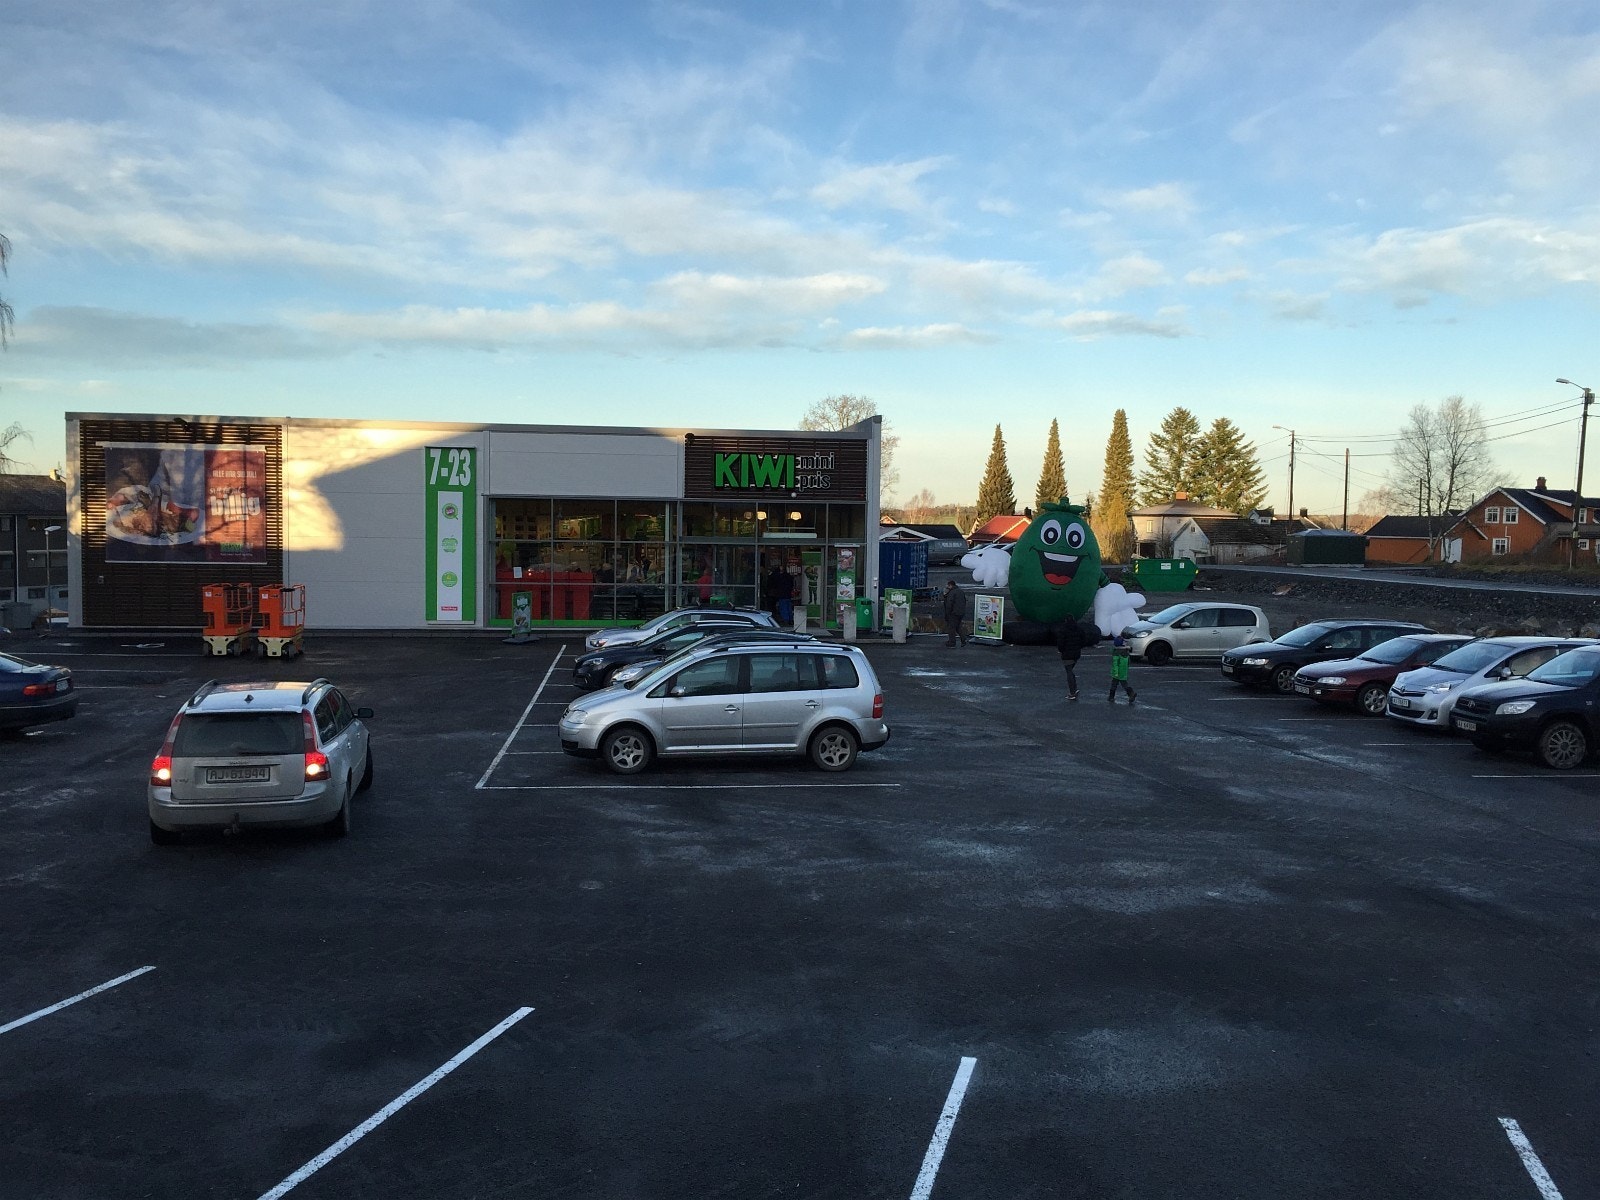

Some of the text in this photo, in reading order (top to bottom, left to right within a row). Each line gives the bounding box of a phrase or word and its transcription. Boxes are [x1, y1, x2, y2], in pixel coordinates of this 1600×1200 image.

[429, 448, 472, 487] 7-23
[715, 453, 795, 488] KIWI
[800, 452, 835, 469] mini
[799, 471, 831, 492] pris
[210, 492, 261, 516] billig
[210, 770, 225, 780] AJ
